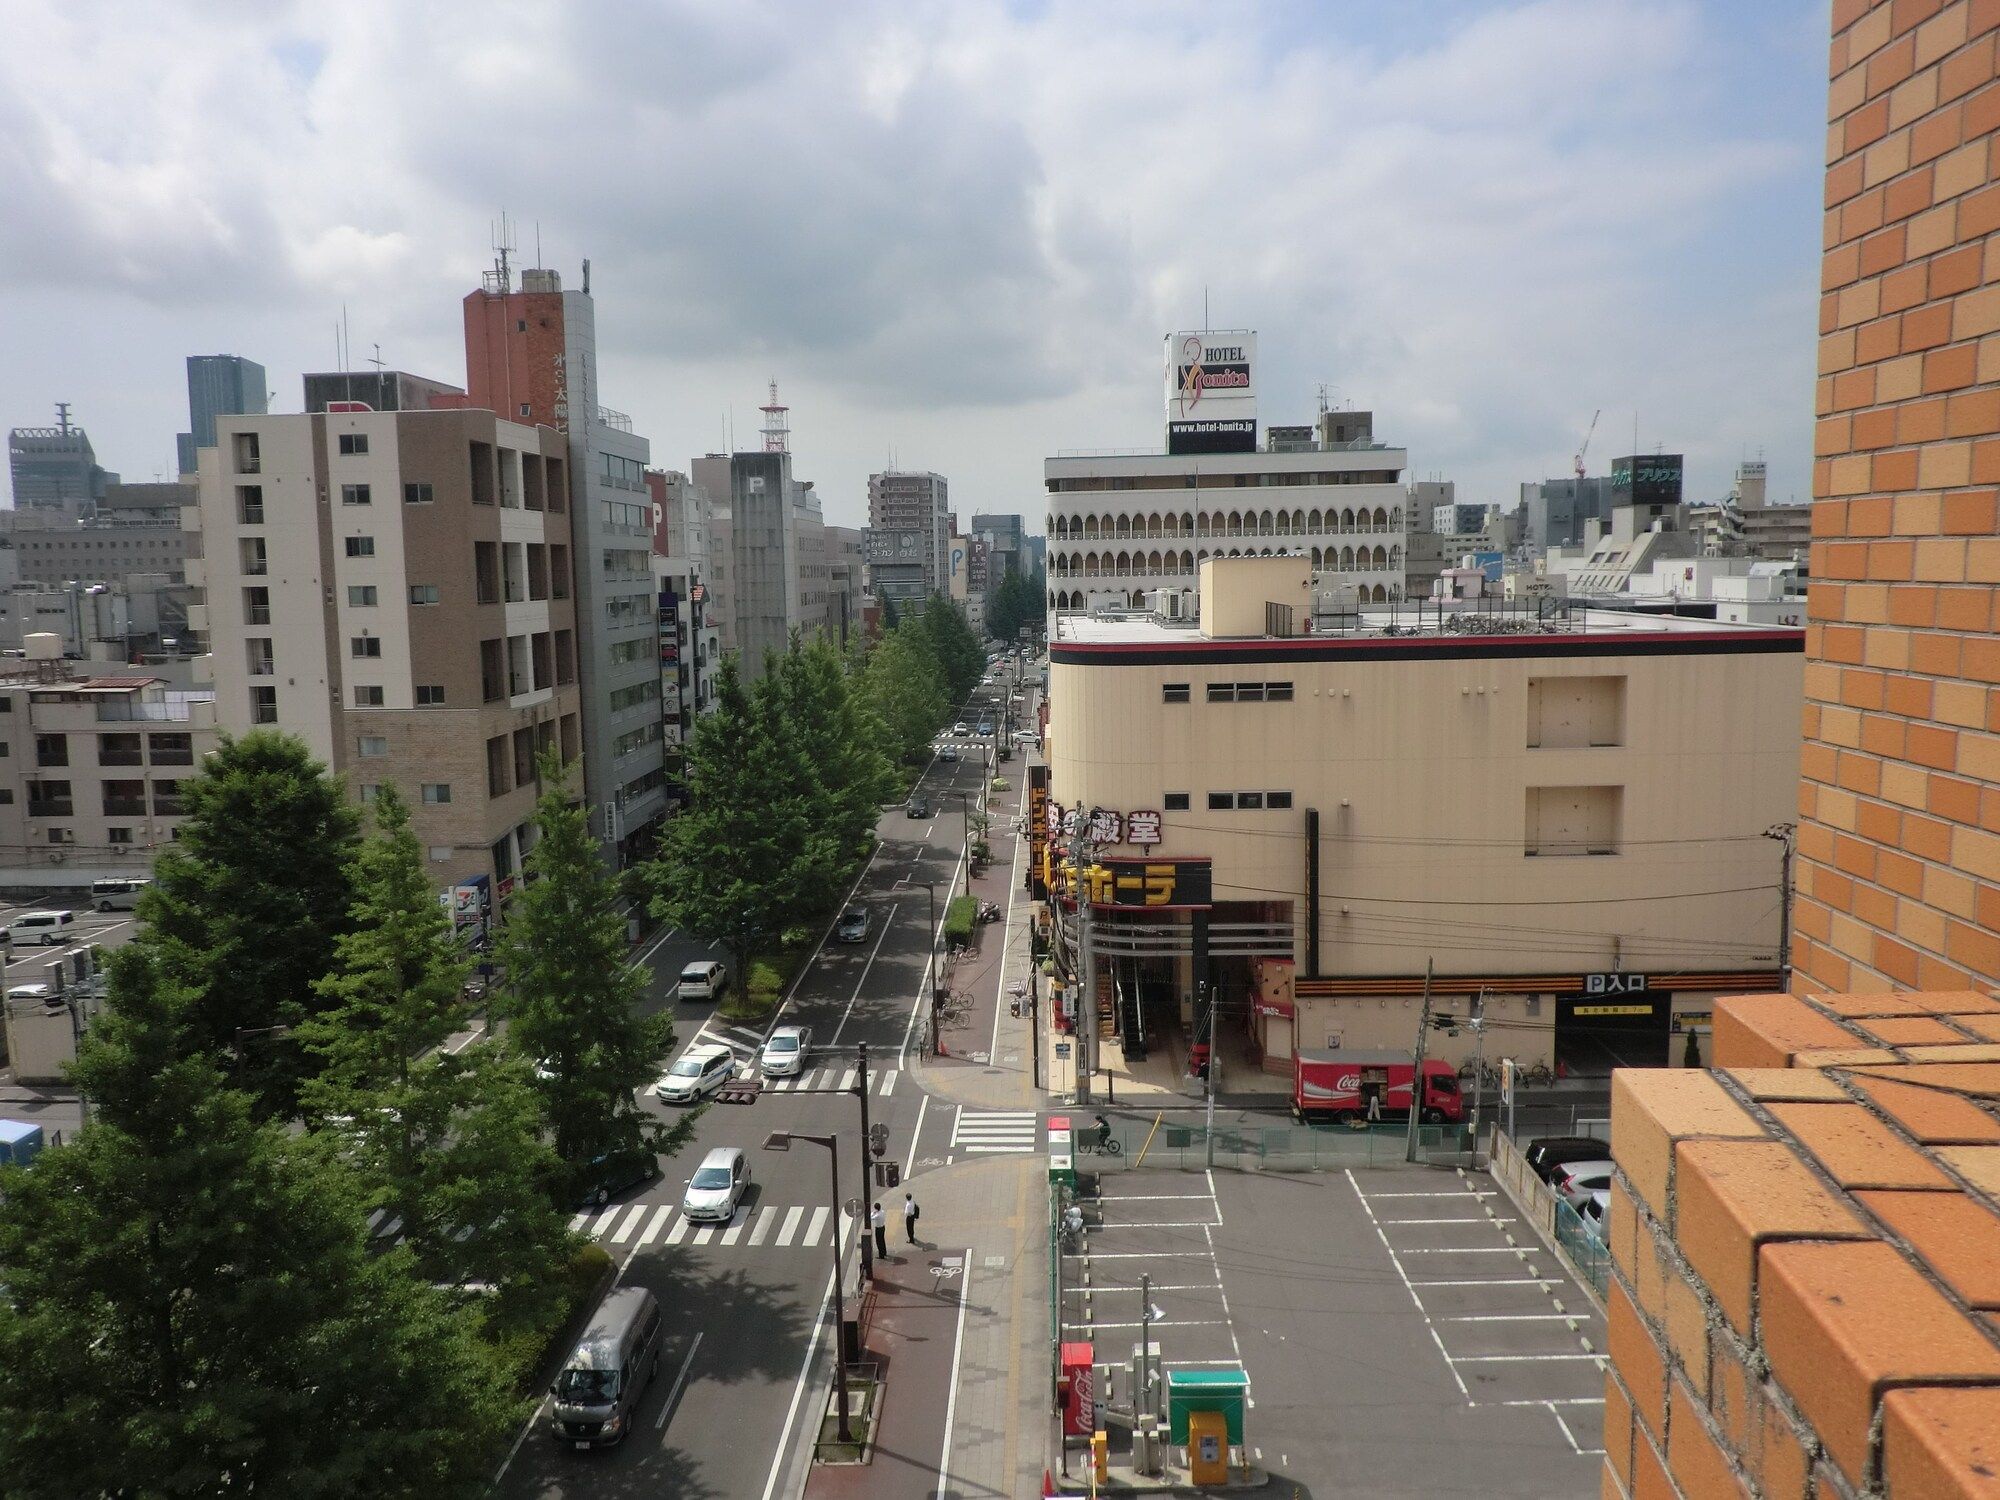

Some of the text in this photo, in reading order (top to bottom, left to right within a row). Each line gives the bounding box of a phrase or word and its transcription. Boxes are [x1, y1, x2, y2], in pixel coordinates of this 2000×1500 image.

[1205, 347, 1245, 361] HOTEL
[1172, 422, 1253, 433] www.hotel-bonita.jp
[1638, 467, 1681, 482] プリウス
[749, 476, 765, 494] P
[652, 502, 663, 536] P
